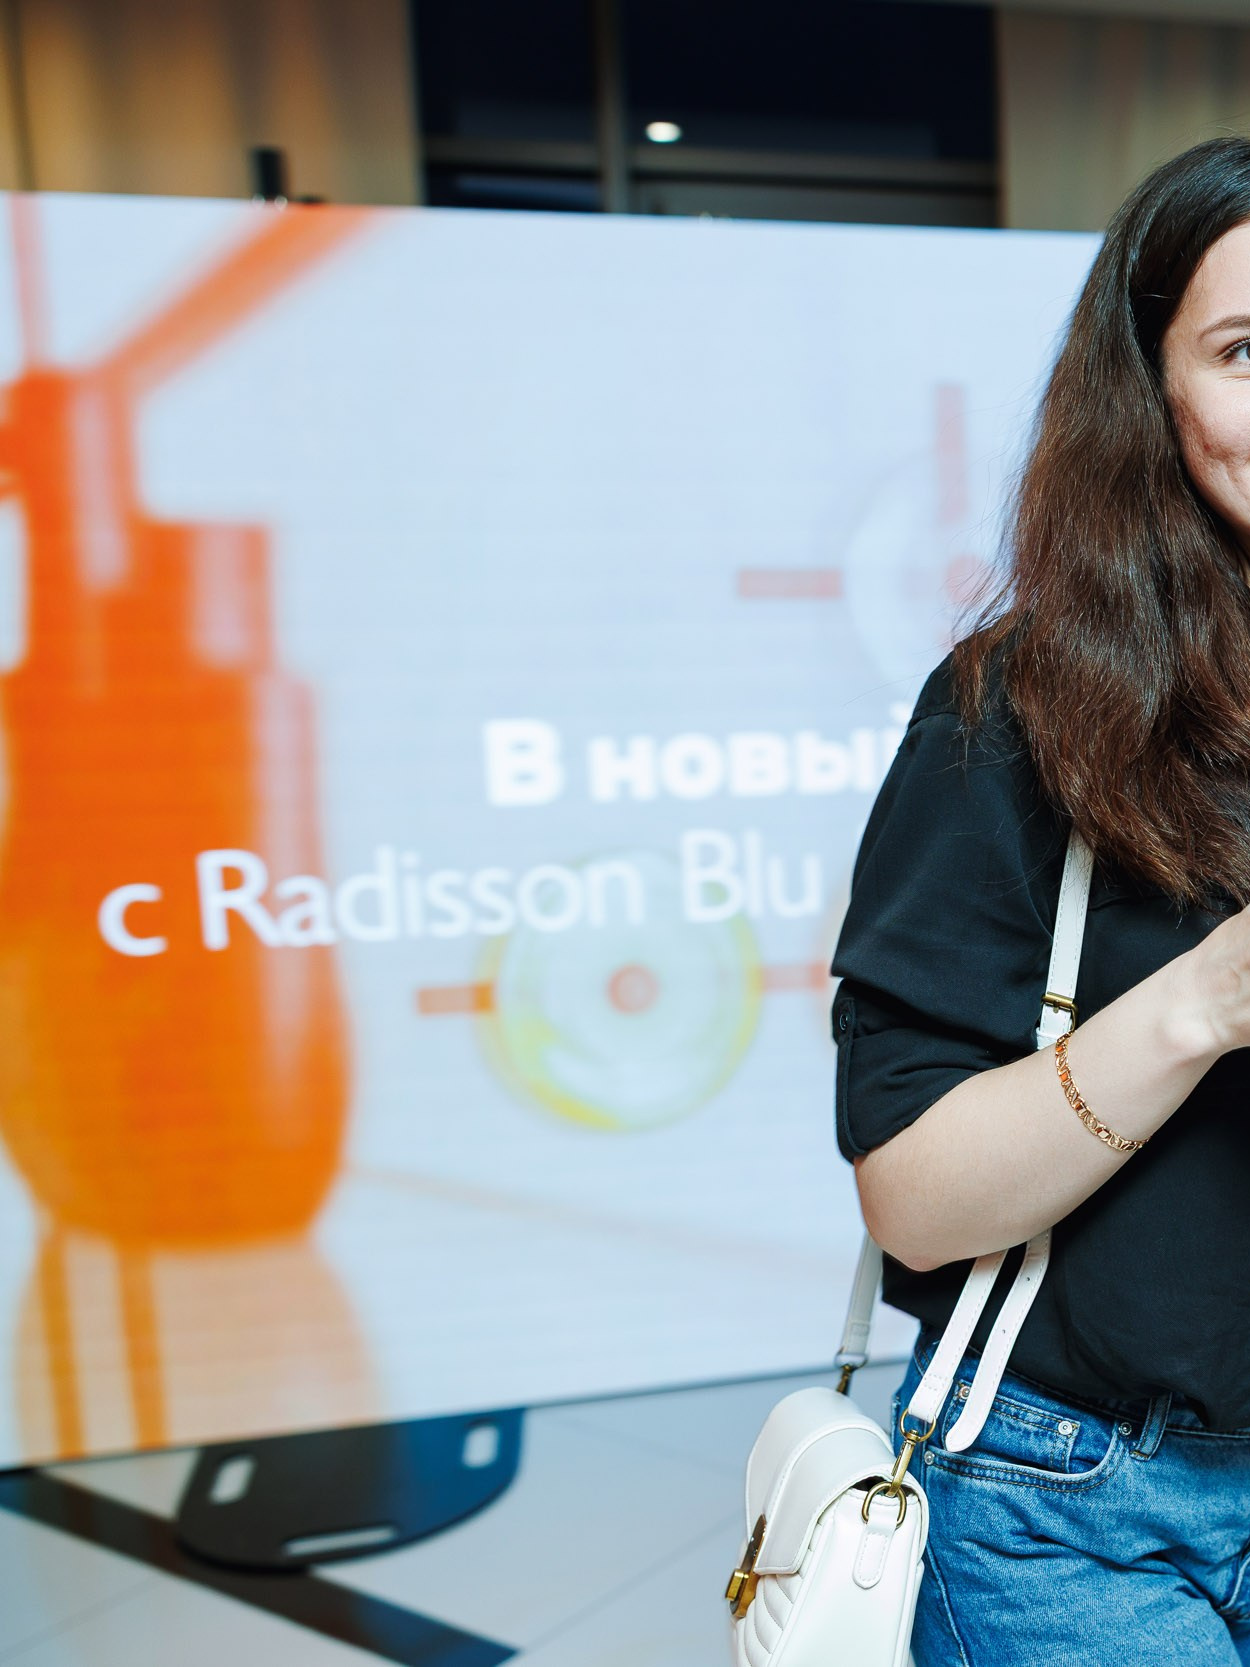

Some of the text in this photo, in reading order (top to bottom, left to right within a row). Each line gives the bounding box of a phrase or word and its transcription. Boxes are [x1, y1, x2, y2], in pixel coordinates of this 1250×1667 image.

[483, 718, 564, 806] В
[98, 828, 824, 957] с Radisson Blu
